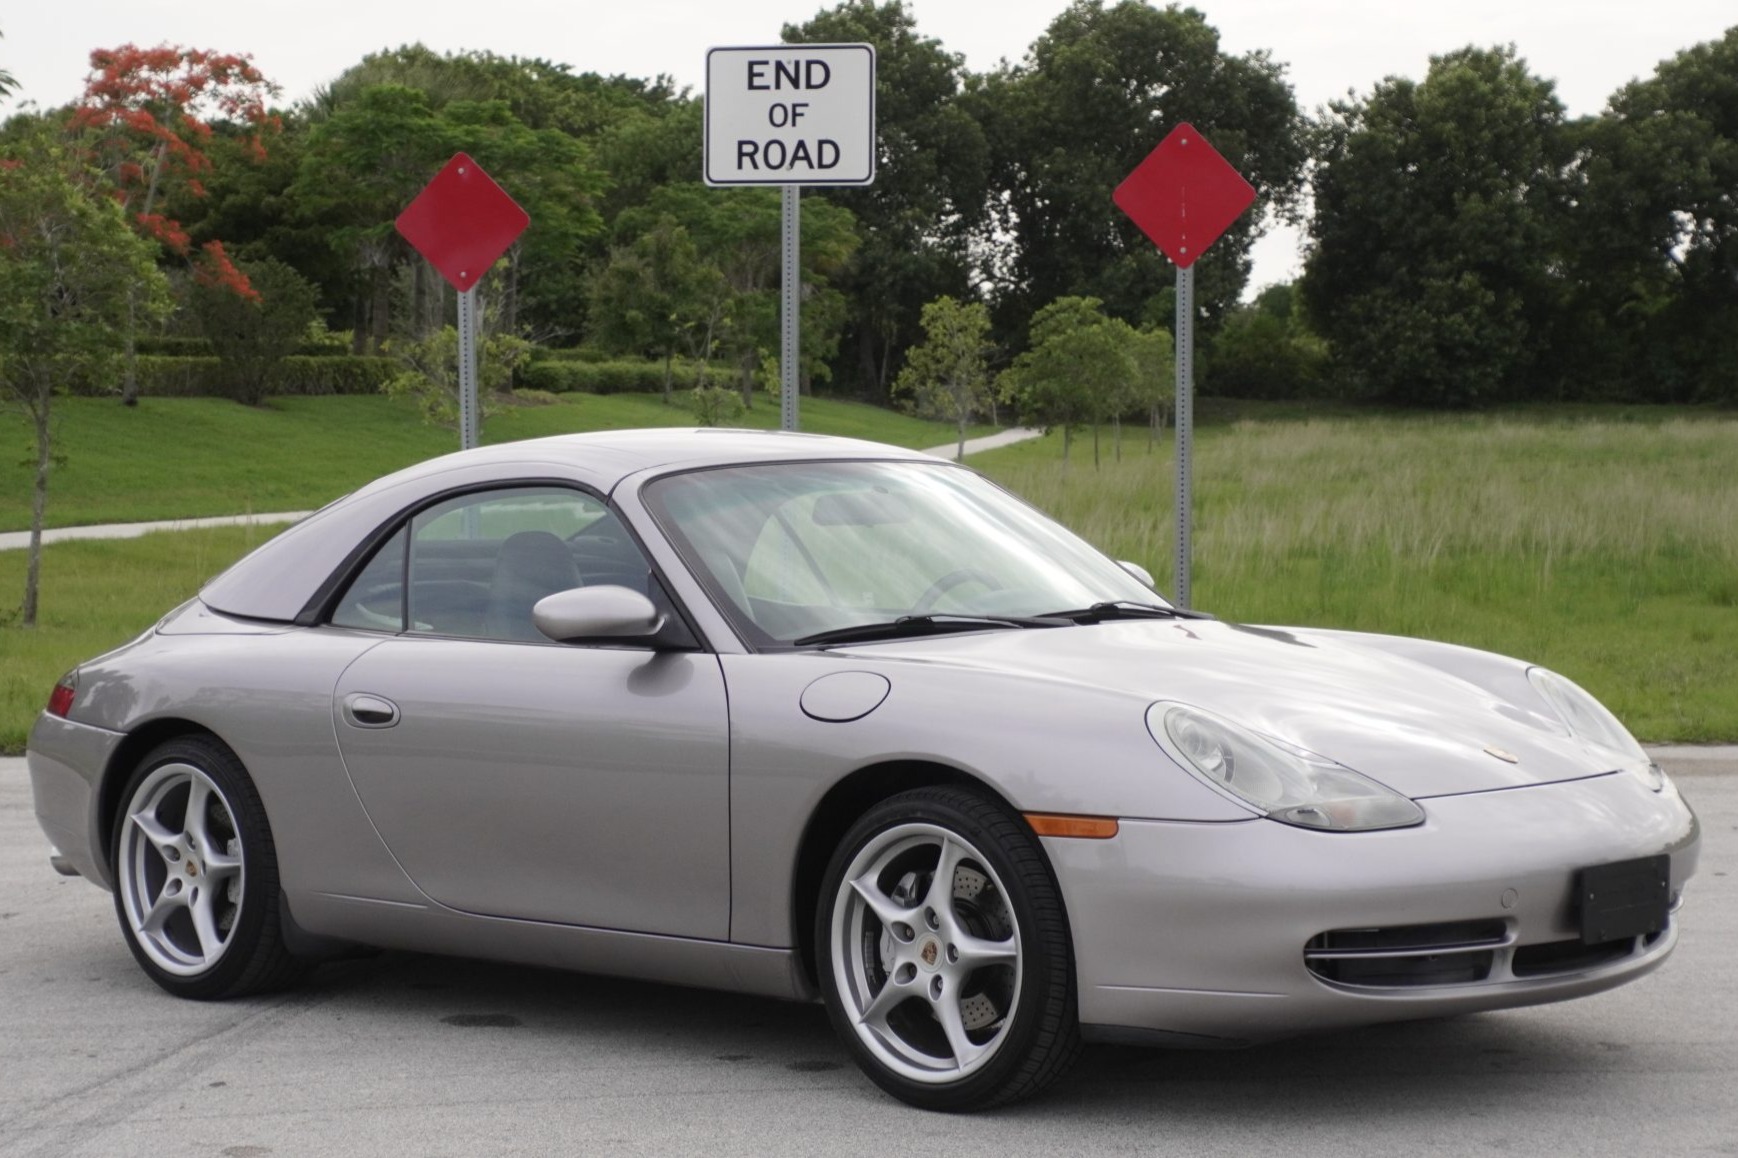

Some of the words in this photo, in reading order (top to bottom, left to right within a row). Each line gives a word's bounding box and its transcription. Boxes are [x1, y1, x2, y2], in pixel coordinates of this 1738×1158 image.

[747, 60, 831, 91] END
[769, 103, 809, 128] OF
[737, 139, 841, 170] ROAD
